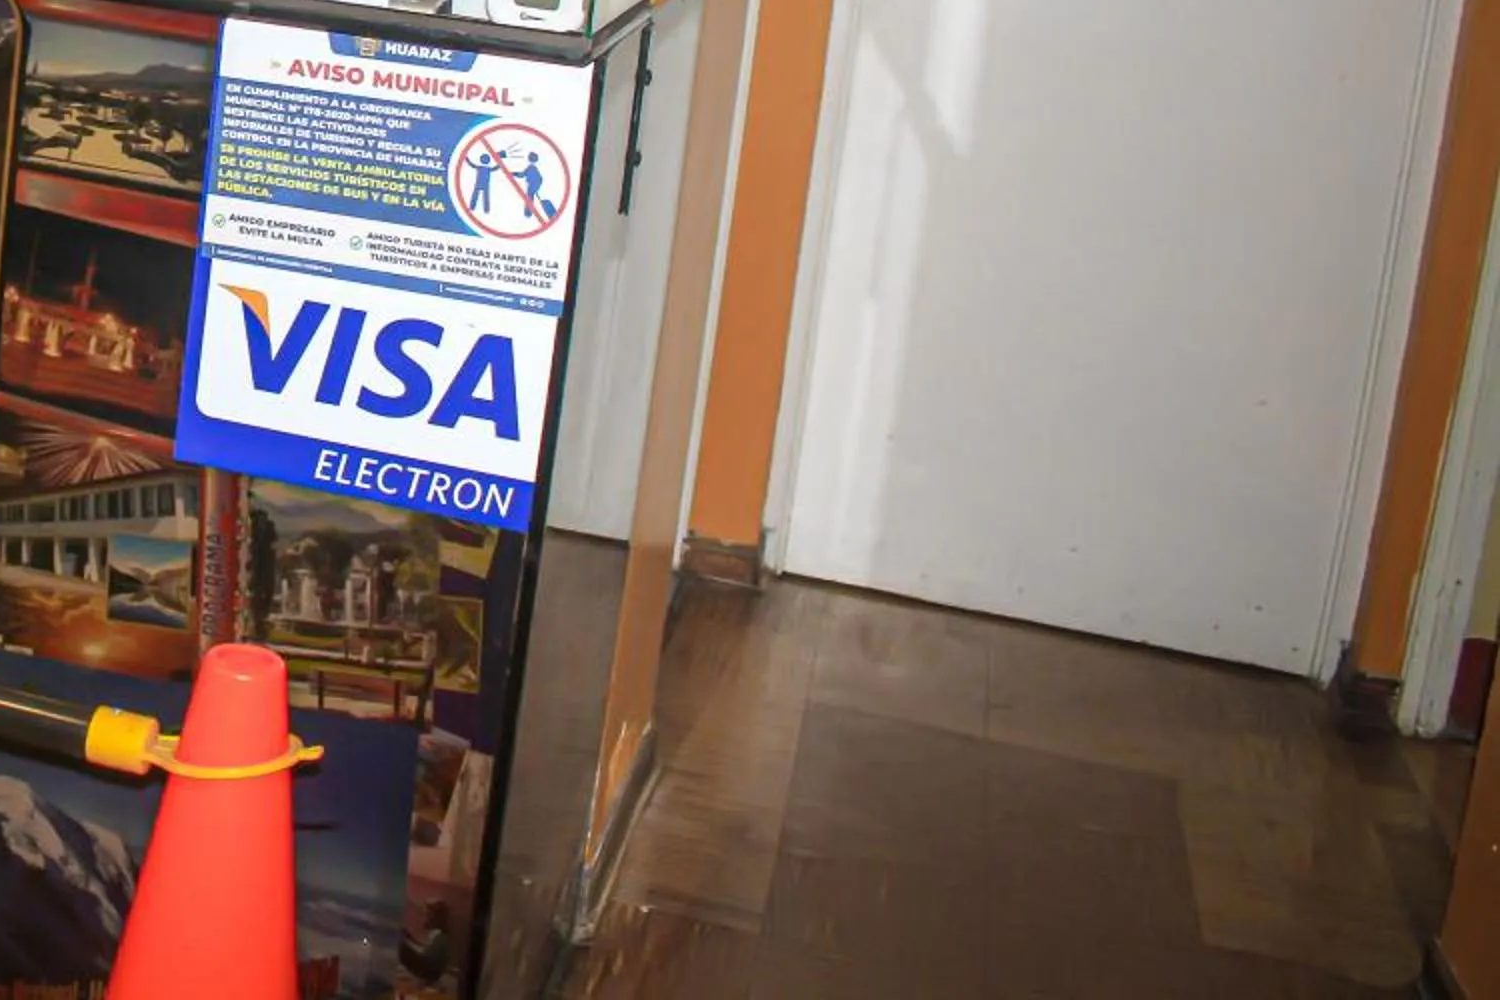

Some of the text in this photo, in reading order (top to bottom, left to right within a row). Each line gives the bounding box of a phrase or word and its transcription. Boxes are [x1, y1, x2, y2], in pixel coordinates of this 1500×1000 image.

[385, 43, 452, 62] HUARAZ
[226, 82, 241, 93] EN
[243, 85, 328, 105] CUMPLIMIENTO
[341, 99, 356, 110] LA
[287, 59, 515, 107] AVISO MUNICIPAL
[225, 93, 285, 111] MUNICIPAL
[385, 117, 411, 129] QUE
[287, 114, 309, 126] LAS
[310, 118, 387, 138] ACTIVIDADES
[222, 128, 274, 144] CONTROL
[275, 136, 290, 146] EN
[292, 139, 309, 149] LA
[310, 142, 372, 159] PROVINCIA
[375, 152, 392, 163] DE
[223, 116, 293, 136] INFORMALES
[295, 127, 311, 138] DE
[367, 138, 375, 148] Y
[425, 147, 441, 158] SU
[219, 154, 236, 165] DE
[239, 157, 262, 170] LOS
[265, 161, 330, 181] SERVICIOS
[408, 184, 426, 196] EN
[292, 153, 308, 164] LA
[310, 156, 350, 171] VENTA
[218, 166, 241, 179] LAS
[243, 170, 320, 192] ESTACIONES
[322, 183, 340, 196] DE
[342, 186, 367, 200] BUS
[370, 190, 380, 202] Y
[382, 192, 400, 206] EN
[402, 196, 419, 209] LA
[229, 213, 336, 236] AMIGO EMPRESARIO
[238, 226, 268, 238] EVITE
[271, 230, 284, 240] LA
[366, 231, 400, 244] AMIGO
[447, 244, 462, 254] NO
[465, 246, 490, 258] SEAS
[493, 251, 525, 264] PARTE
[529, 256, 542, 267] DE
[545, 259, 558, 269] LA
[366, 241, 556, 280] INFORMALIDAD CONTRATA SERVICIOS
[440, 263, 494, 280] EMPRESAS
[496, 272, 551, 289] FORMALES
[218, 283, 521, 442] VISA
[313, 449, 515, 519] ELECTRON
